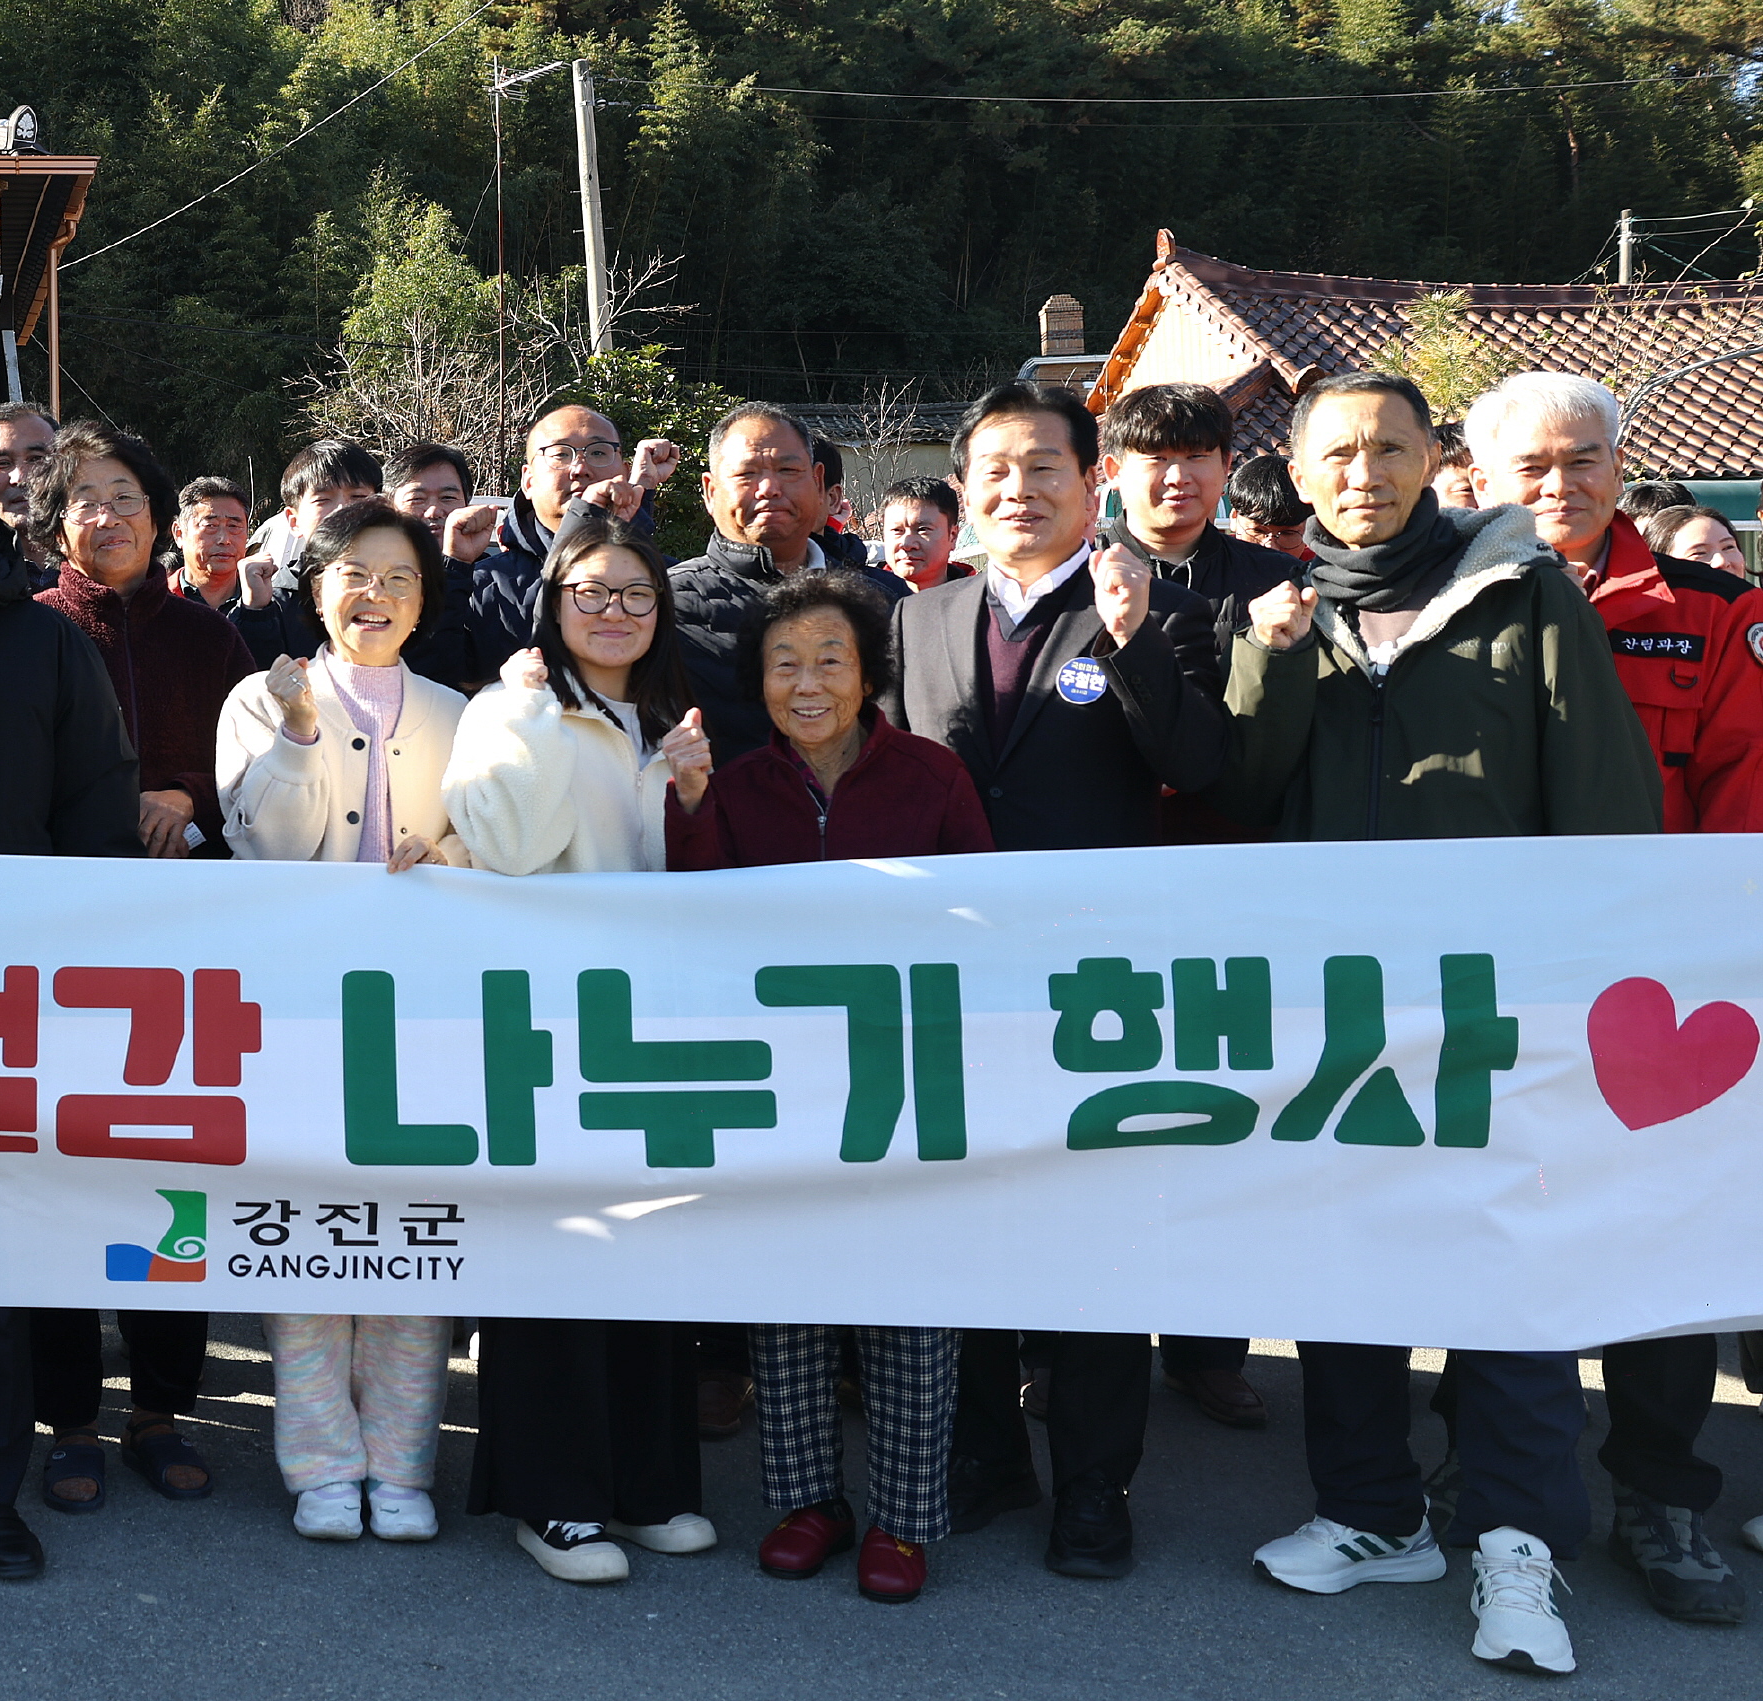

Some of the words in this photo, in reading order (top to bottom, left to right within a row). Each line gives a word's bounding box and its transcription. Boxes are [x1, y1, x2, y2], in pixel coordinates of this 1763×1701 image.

[1621, 637, 1693, 655] 산림과장
[341, 962, 967, 1168] 나누기
[1048, 953, 1519, 1149] 행사
[232, 1199, 465, 1247] 강진군
[227, 1254, 465, 1281] GANGJINCITY
